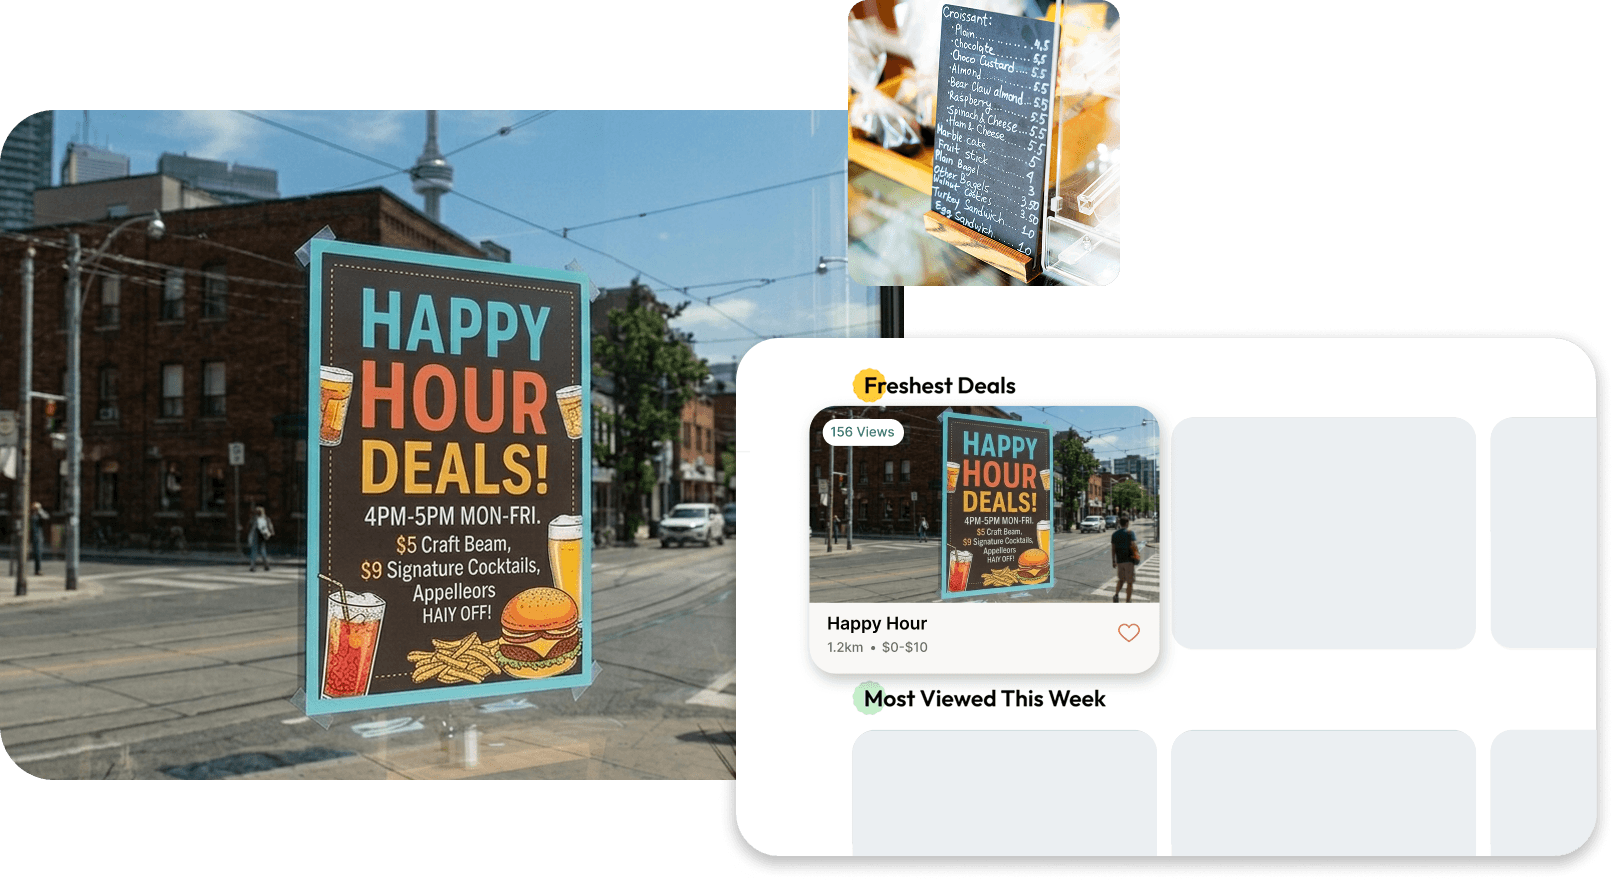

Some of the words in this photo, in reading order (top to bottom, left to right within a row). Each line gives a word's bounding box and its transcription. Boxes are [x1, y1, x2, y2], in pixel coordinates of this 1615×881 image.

[943, 6, 992, 26] Croissant:
[955, 24, 975, 38] Plain
[954, 39, 995, 56] Chocolate
[951, 64, 982, 80] Almond
[952, 49, 976, 63] Choco
[980, 55, 1015, 73] Custard
[949, 91, 992, 114] Raspberry
[950, 77, 968, 89] Bear
[972, 82, 991, 95] Claw
[994, 85, 1024, 105] almond
[948, 105, 978, 122] Spinach
[987, 115, 1018, 132] Cheese
[937, 124, 962, 142] Marble
[966, 137, 986, 150] cake
[1028, 156, 1041, 168] 5
[948, 116, 966, 129] Ham
[968, 123, 974, 131] &
[976, 124, 1005, 142] Cheese
[1027, 140, 1046, 156] 5.5
[935, 150, 954, 165] Plain
[957, 159, 980, 176] Bagel
[1028, 186, 1035, 196] 3
[938, 139, 960, 154] Fruit
[965, 151, 988, 165] stick
[1026, 171, 1034, 184] 4
[933, 174, 960, 192] Walnut
[934, 166, 958, 180] Other
[960, 172, 990, 194] Bagels
[1020, 196, 1040, 211] 3.50
[932, 186, 960, 210] Turkey
[964, 199, 1005, 226] Sandwich
[1022, 225, 1035, 239] 10
[935, 200, 952, 218] Egg
[954, 212, 994, 238] Sandwich
[1017, 242, 1032, 256] 10
[361, 287, 552, 362] HAPPY
[360, 359, 549, 435] HOUR
[864, 376, 953, 395] Freshest
[958, 376, 1016, 395] Deals
[831, 426, 853, 437] 156
[857, 426, 895, 438] Views
[962, 431, 1038, 461] HAPPY
[360, 439, 549, 496] DEALS!
[962, 459, 1037, 489] HOUR
[962, 490, 1038, 513] DEALS!
[364, 505, 455, 527] 4PM-5PM
[460, 505, 541, 526] MON-FRI.
[964, 517, 1000, 525] 4PM-5PM
[962, 538, 972, 546] $9
[973, 538, 1003, 547] Signature
[1005, 537, 1033, 545] Cocktails,
[976, 528, 986, 536] $5
[396, 534, 417, 555] $5
[421, 534, 460, 554] Craft
[464, 535, 512, 553] Beam,
[360, 560, 383, 581] $9
[386, 559, 465, 584] Signature
[467, 554, 542, 578] Cocktails,
[412, 582, 496, 605] Appelleors
[460, 605, 491, 621] OFF!
[827, 616, 882, 633] Happy
[887, 616, 927, 631] Hour
[827, 641, 863, 653] 1.2km
[882, 640, 928, 654] $0-$10
[864, 689, 916, 708] Most
[920, 689, 996, 708] Viewed
[1001, 689, 1044, 708] This
[1048, 689, 1106, 708] Week
